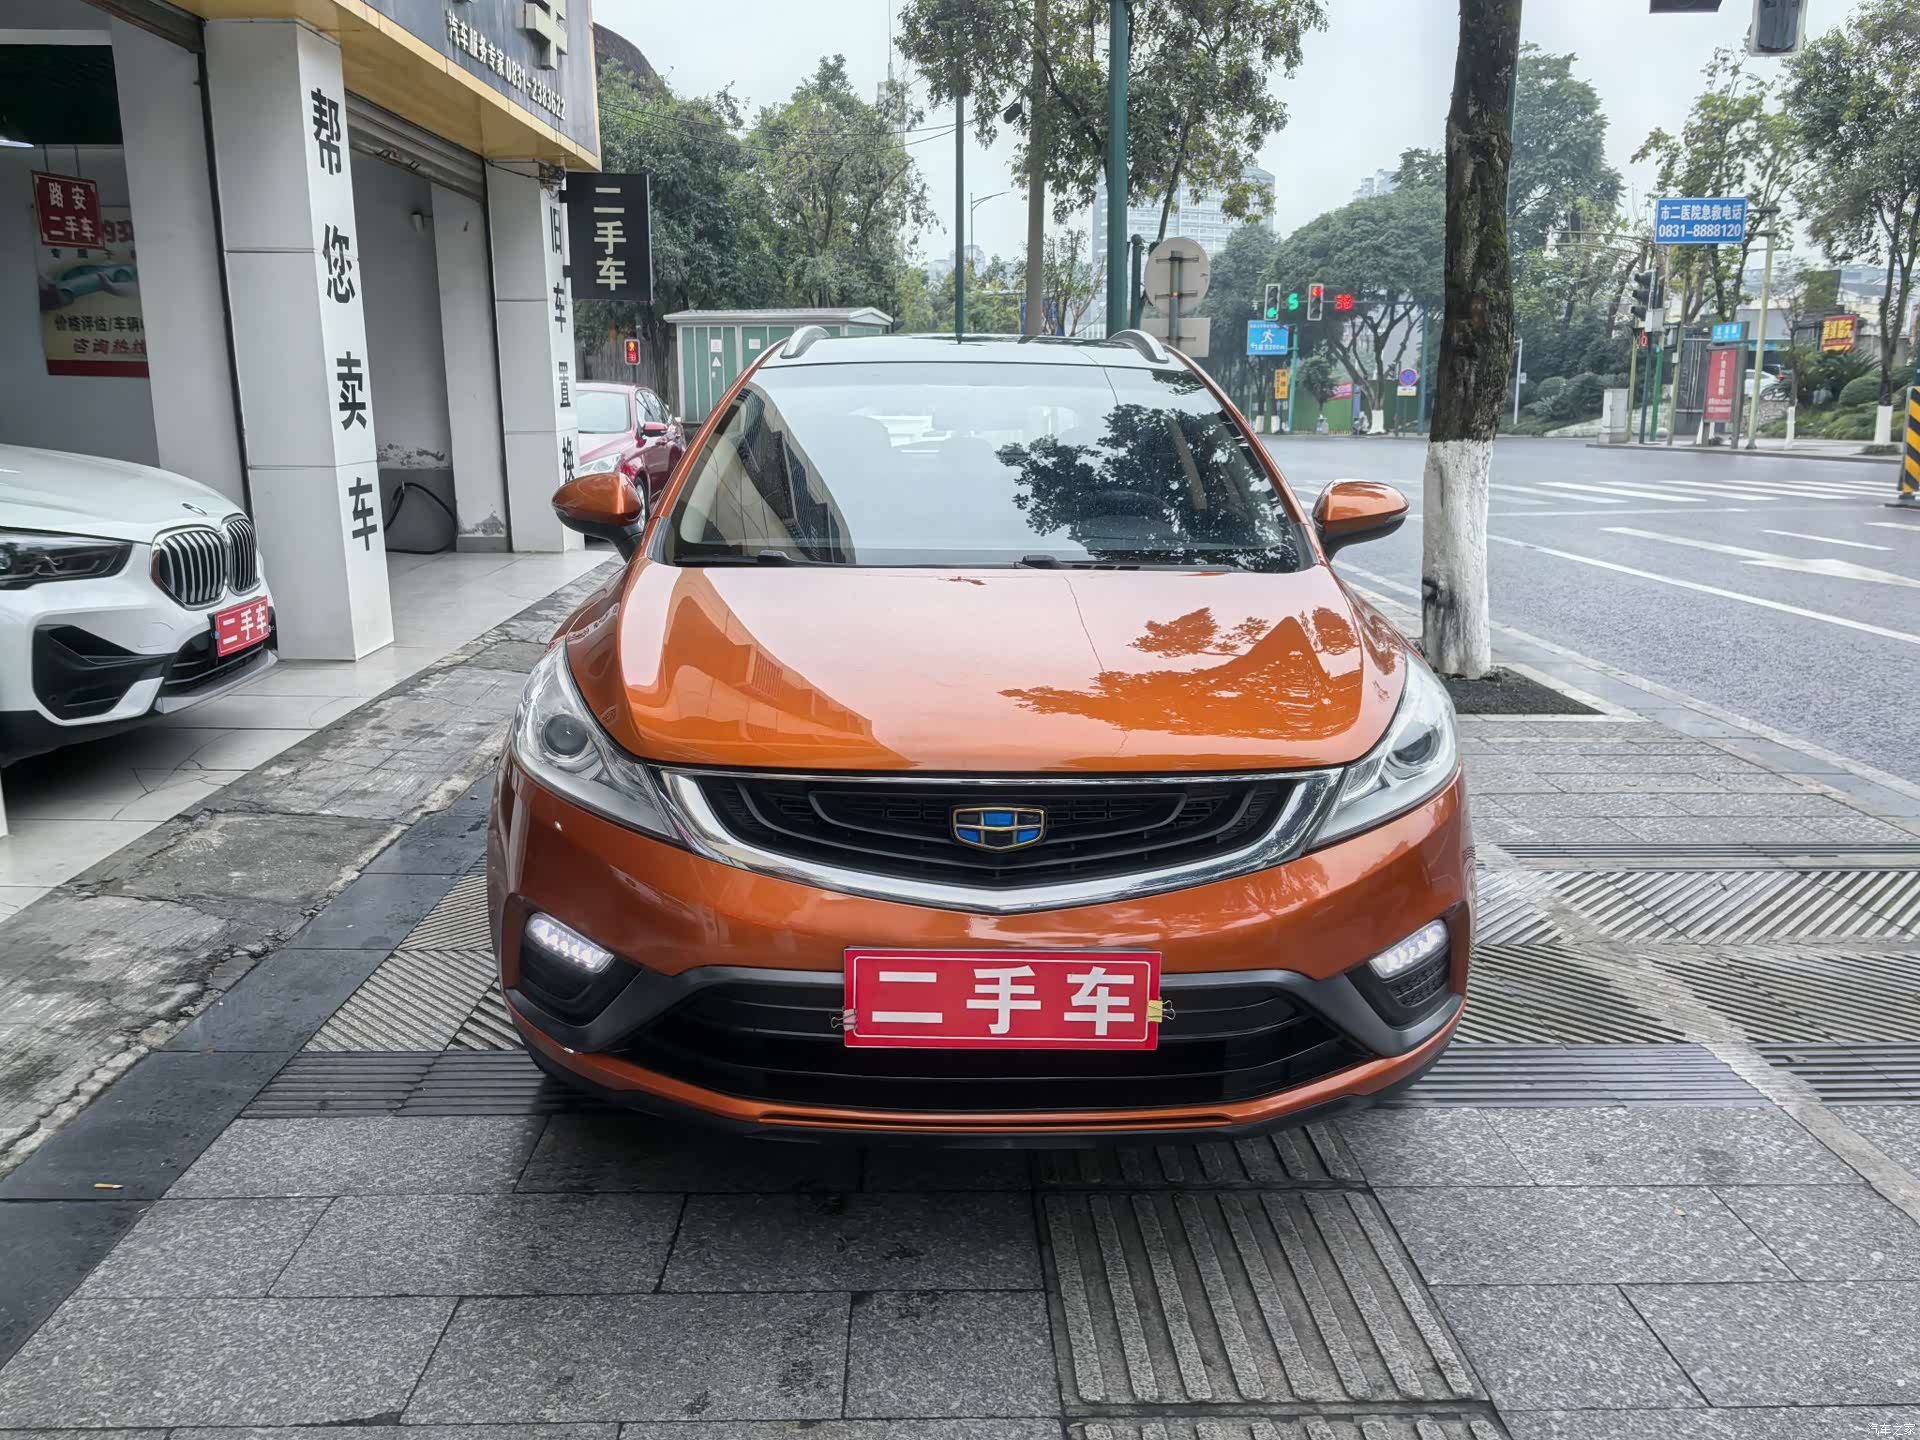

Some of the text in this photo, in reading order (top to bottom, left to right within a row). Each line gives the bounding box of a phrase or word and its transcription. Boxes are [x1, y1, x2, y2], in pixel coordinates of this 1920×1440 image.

[48, 182, 87, 210] 路安
[1660, 204, 1743, 221] 市二医院急救电话
[48, 215, 96, 243] 二手车
[593, 187, 627, 291] 二手车
[1658, 223, 1741, 238] 0831-8888120
[310, 87, 378, 552] 帮您卖车
[222, 604, 267, 645] 二手车
[871, 965, 1135, 1036] 二手车
